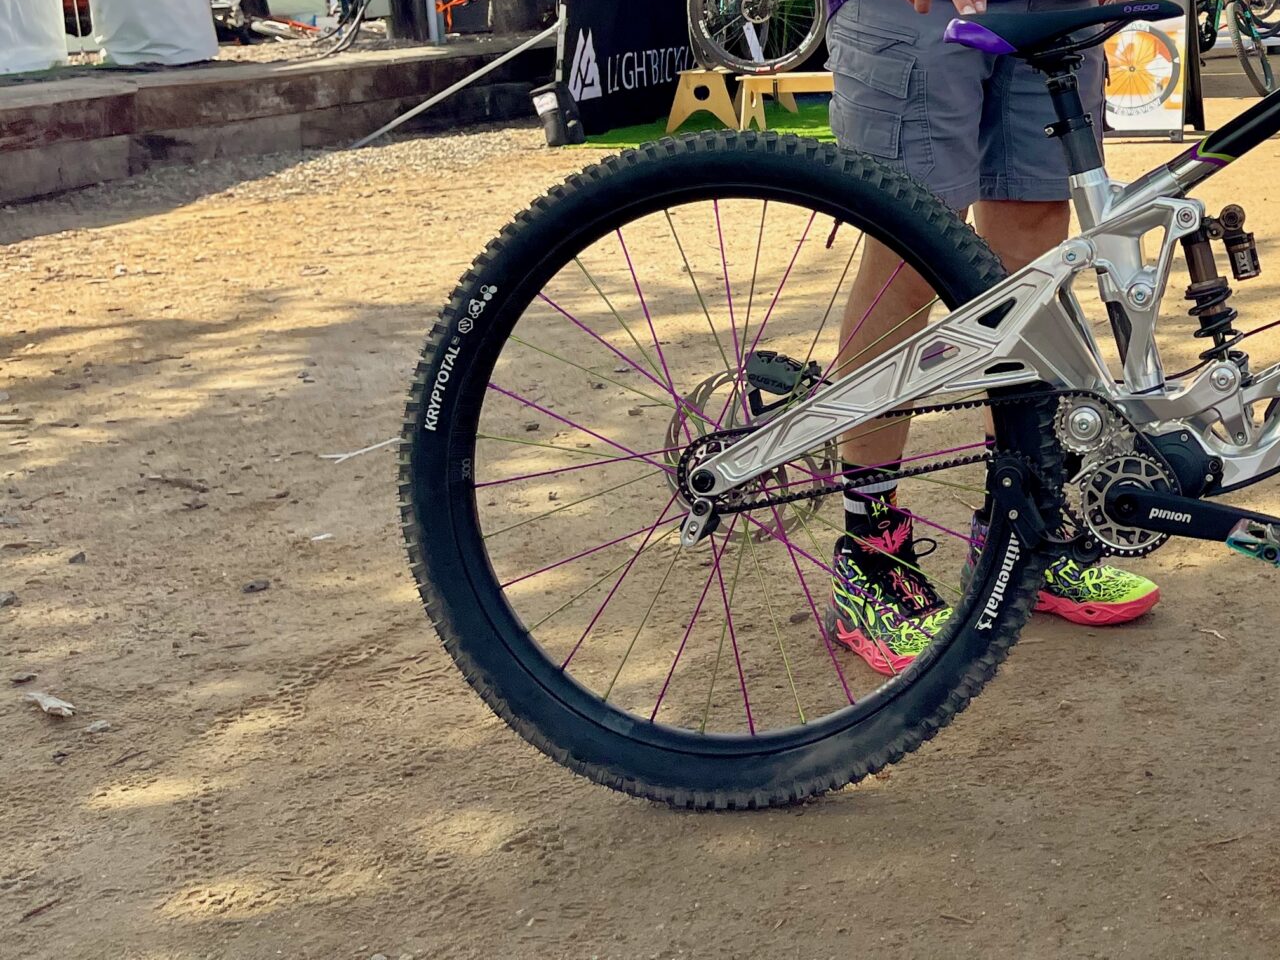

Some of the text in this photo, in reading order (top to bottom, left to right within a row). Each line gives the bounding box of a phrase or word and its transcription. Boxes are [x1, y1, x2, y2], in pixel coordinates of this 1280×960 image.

[1133, 4, 1159, 12] SDG
[424, 345, 461, 432] KRYPTOTAL
[1149, 507, 1192, 524] pinion
[983, 531, 1020, 619] ntinental
